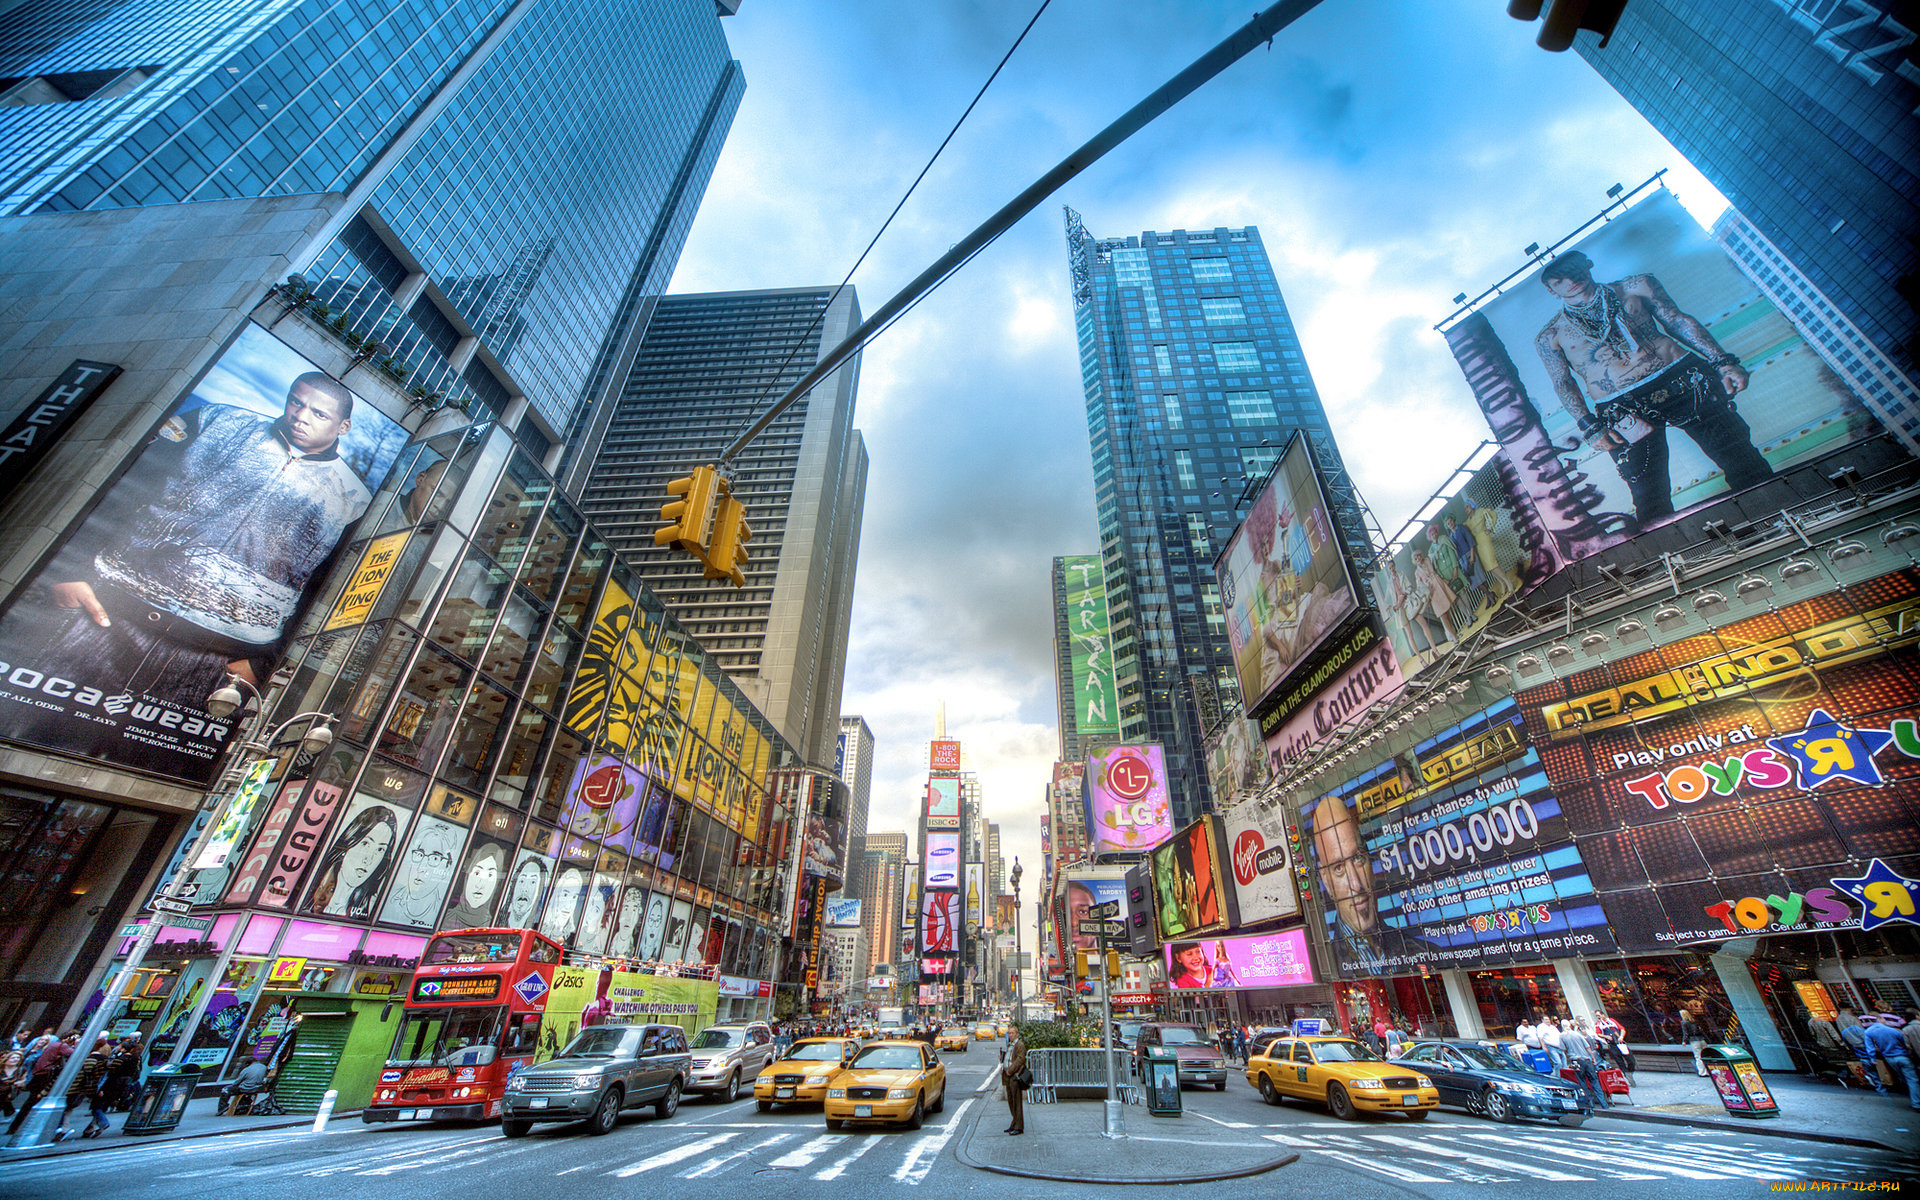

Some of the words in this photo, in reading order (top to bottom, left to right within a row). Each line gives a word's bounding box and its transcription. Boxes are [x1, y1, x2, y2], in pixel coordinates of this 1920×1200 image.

[370, 550, 393, 565] THE
[350, 567, 388, 592] LION
[335, 591, 375, 617] KING
[1262, 707, 1283, 733] BORN
[1280, 703, 1289, 719] IN
[1286, 692, 1302, 711] THE
[1301, 645, 1353, 697] GLAMOROUS
[1352, 626, 1374, 652] USA
[1313, 647, 1397, 737] Couture
[1554, 668, 1688, 730] DEAL
[1687, 662, 1710, 703] OR
[1707, 645, 1804, 690] NO
[13, 694, 33, 705] ALL
[35, 699, 65, 713] ODDS
[142, 694, 157, 703] WE
[158, 699, 183, 711] RUN
[183, 705, 204, 717] THE
[203, 712, 234, 725] STRIP
[74, 710, 91, 720] DR.
[93, 715, 118, 727] JAYS
[122, 732, 214, 759] WWW.ROCAWEAR.COM
[125, 725, 156, 738] JIMMY
[157, 733, 180, 743] JAZZ
[721, 720, 742, 755] THE
[1612, 743, 1665, 770] Play
[1669, 733, 1724, 762] only
[1727, 722, 1760, 746] at
[185, 741, 217, 753] MACY'S
[684, 727, 727, 791] LION
[1356, 777, 1403, 811] DEAL
[1449, 727, 1517, 772] DEAL
[1623, 747, 1792, 810] TOYS
[384, 776, 404, 790] we
[441, 792, 464, 816] MTV
[1114, 803, 1154, 827] LG
[1382, 820, 1403, 837] Play
[1404, 815, 1420, 828] for
[1422, 811, 1429, 821] a
[1431, 794, 1474, 818] chance
[1475, 787, 1490, 801] to
[1493, 776, 1520, 797] win
[495, 817, 508, 829] all
[928, 818, 948, 826] HSBC
[232, 786, 304, 894] PEACE
[267, 787, 336, 898] PEACE
[1379, 797, 1539, 881] $1,000,000
[570, 845, 590, 859] speak
[1236, 835, 1258, 879] Virgin
[1258, 850, 1283, 871] mobile
[1400, 888, 1409, 899] or
[1417, 881, 1433, 897] trip
[1434, 878, 1443, 891] to
[1444, 874, 1461, 889] the
[1463, 866, 1495, 887] show,
[1497, 864, 1509, 876] or
[1512, 857, 1537, 873] over
[815, 878, 826, 923] KODAK
[1401, 897, 1435, 915] 100,000
[1438, 892, 1462, 908] other
[1465, 882, 1510, 905] amazing
[1512, 871, 1552, 895] prizes!
[174, 902, 187, 911] WAY
[1704, 888, 1852, 934] TOYS
[1084, 924, 1098, 932] ONE
[1424, 925, 1440, 938] Play
[1441, 921, 1457, 935] only
[1457, 923, 1467, 932] at
[1468, 908, 1506, 934] TOYS
[1526, 904, 1552, 924] US
[810, 924, 821, 968] digital
[1655, 929, 1695, 942] Subject
[1696, 929, 1706, 938] to
[1342, 960, 1360, 971] Check
[1360, 958, 1370, 969] this
[1483, 942, 1508, 956] insert
[1509, 938, 1523, 953] for
[1525, 941, 1532, 951] a
[1532, 937, 1562, 954] game
[1564, 932, 1600, 948] piece.
[276, 960, 298, 977] MTV
[564, 974, 585, 988] asics
[479, 979, 497, 987] LOOP
[519, 982, 532, 992] GRAY
[532, 982, 544, 992] LINE
[614, 987, 645, 997] CHALLENGE:
[614, 1002, 649, 1014] WATCHING
[649, 1002, 673, 1014] OTHERS
[673, 1003, 687, 1014] PASS
[686, 1003, 698, 1014] YOU
[1121, 995, 1147, 1003] swatch
[397, 1067, 450, 1091] Broadway
